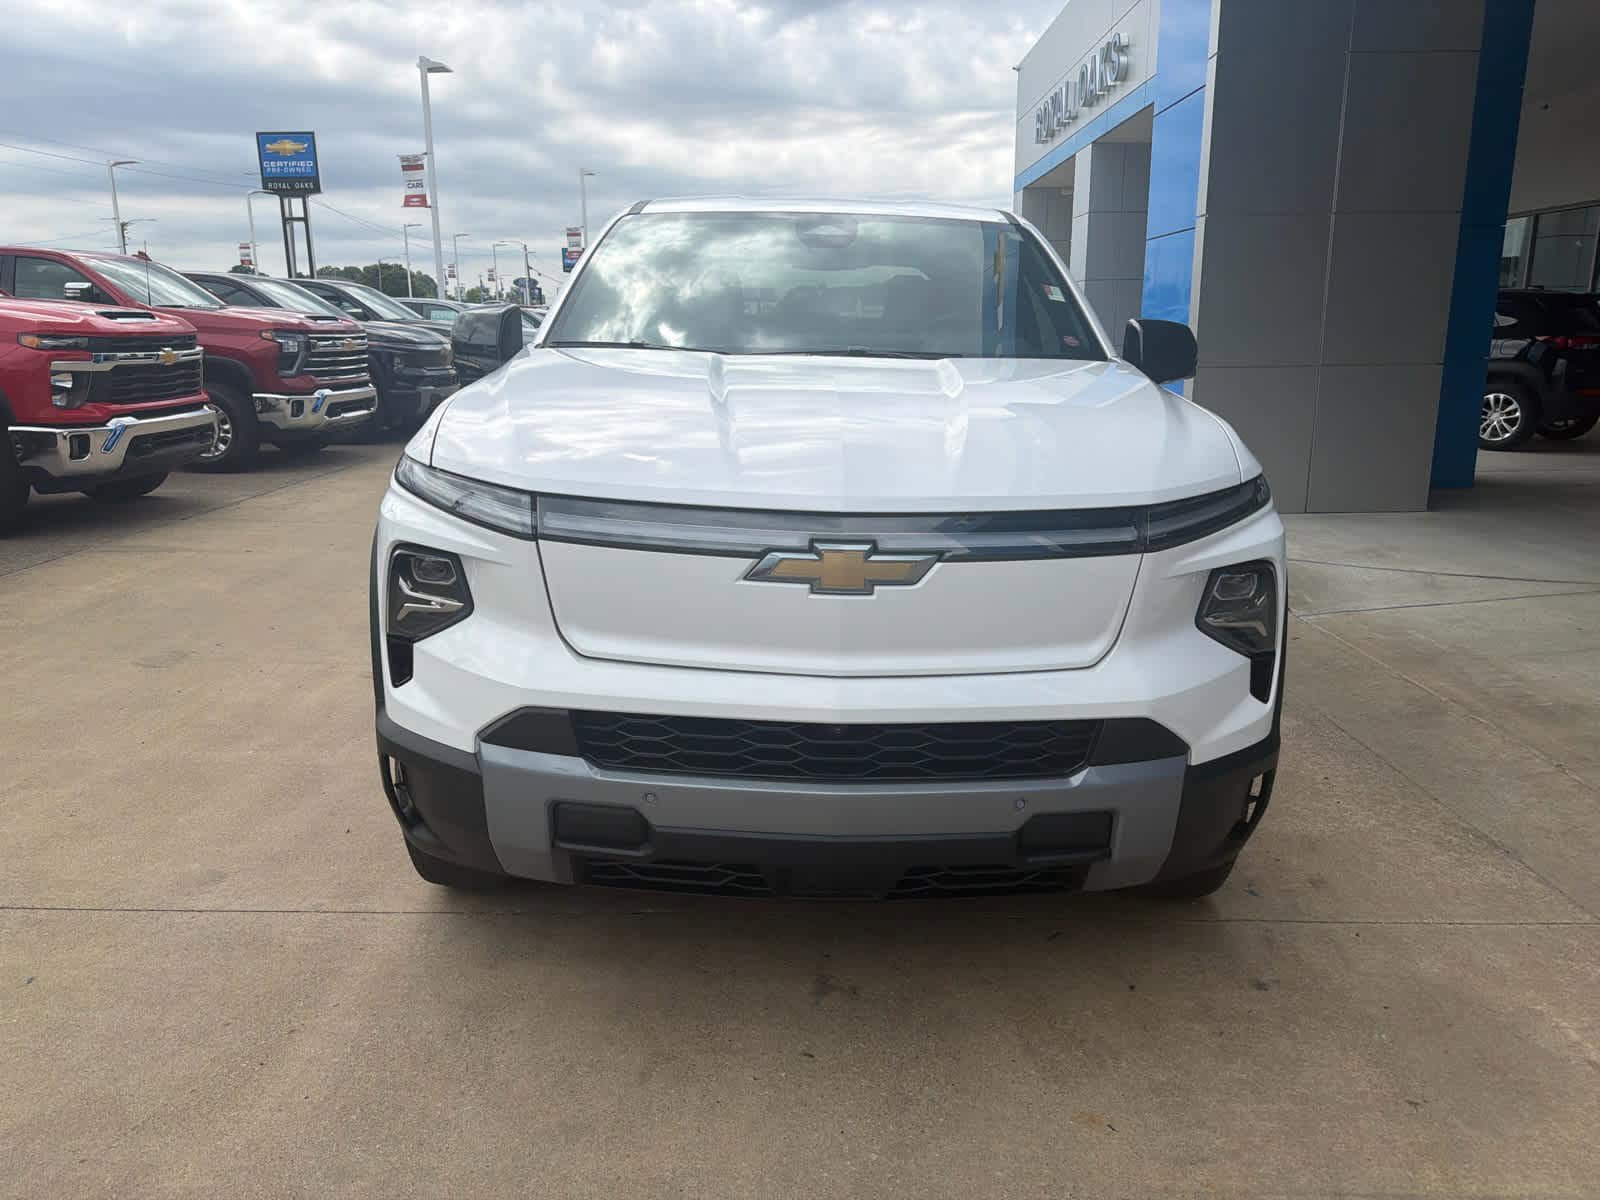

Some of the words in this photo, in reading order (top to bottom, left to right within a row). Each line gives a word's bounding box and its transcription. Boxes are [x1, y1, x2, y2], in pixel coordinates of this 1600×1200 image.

[1035, 81, 1074, 145] ROYAL
[1079, 32, 1128, 108] OAKS
[263, 160, 313, 168] CERTIFIED
[268, 182, 291, 190] ROYAL
